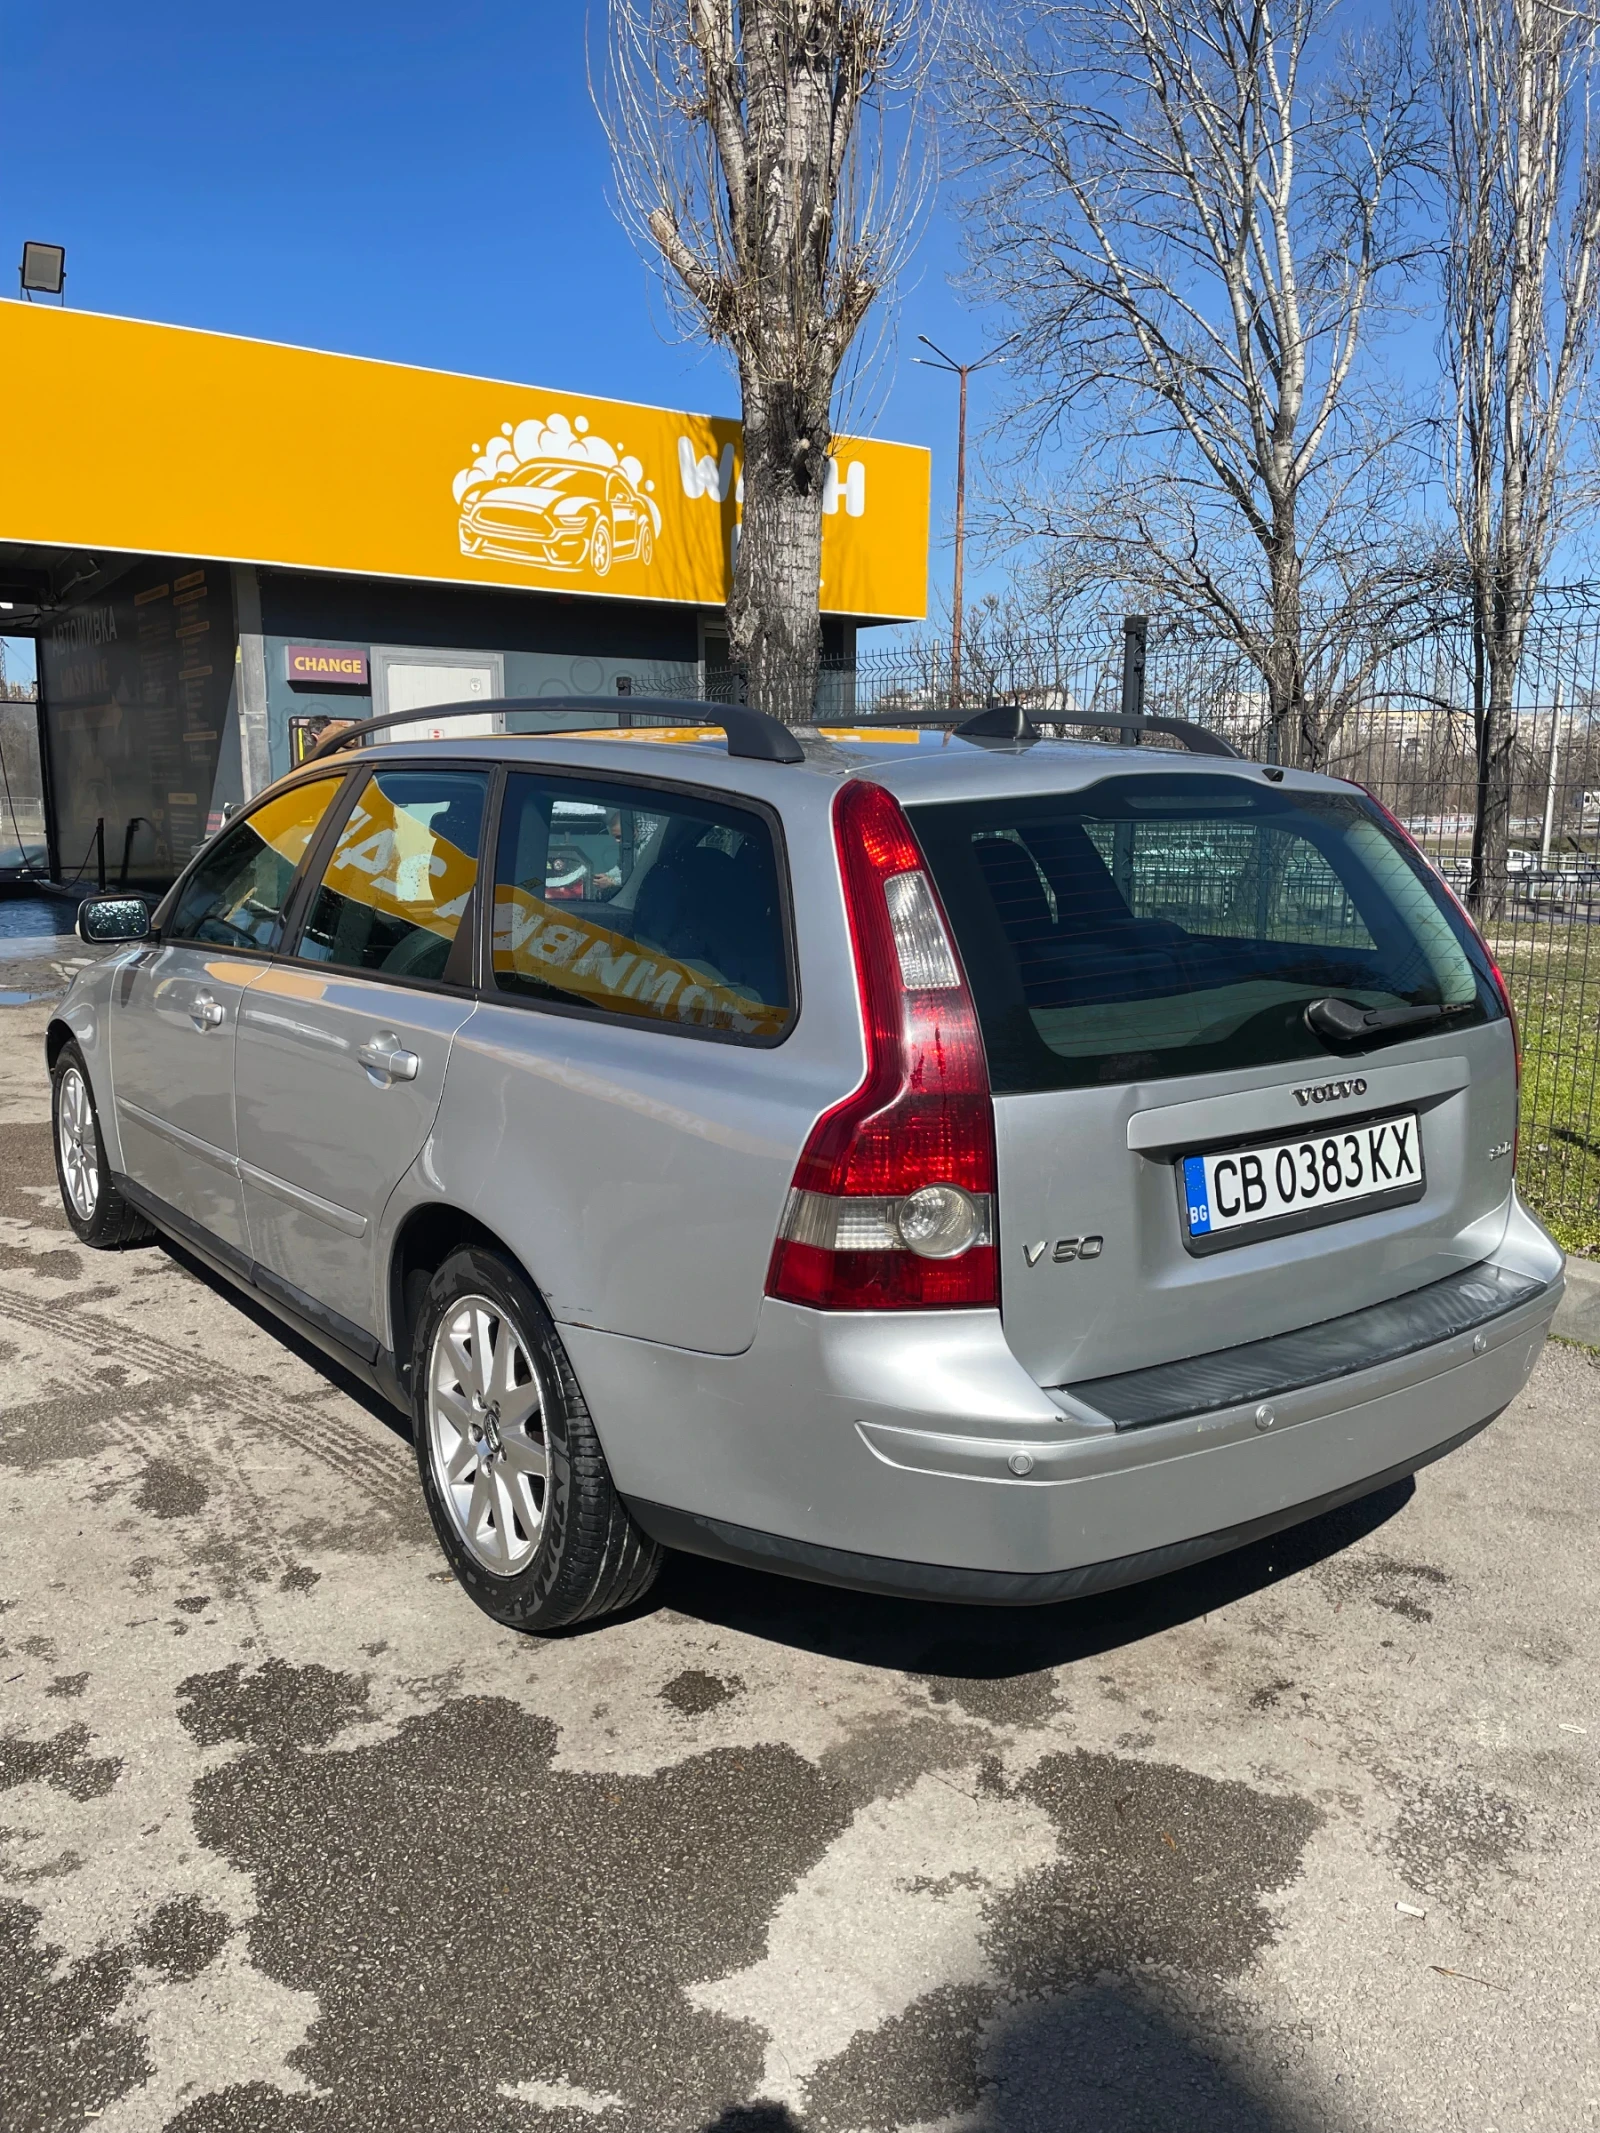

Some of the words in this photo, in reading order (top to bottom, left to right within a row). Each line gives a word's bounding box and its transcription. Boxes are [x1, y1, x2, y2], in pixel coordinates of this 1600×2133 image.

[678, 436, 865, 518] WH
[52, 606, 118, 658] АВТОМИВКА
[294, 656, 362, 674] CHANGE
[1292, 1078, 1368, 1106] VOLVO
[1213, 1160, 1268, 1218] CB
[1276, 1136, 1363, 1204] 0383
[1371, 1122, 1415, 1184] KX
[1189, 1206, 1208, 1225] BG
